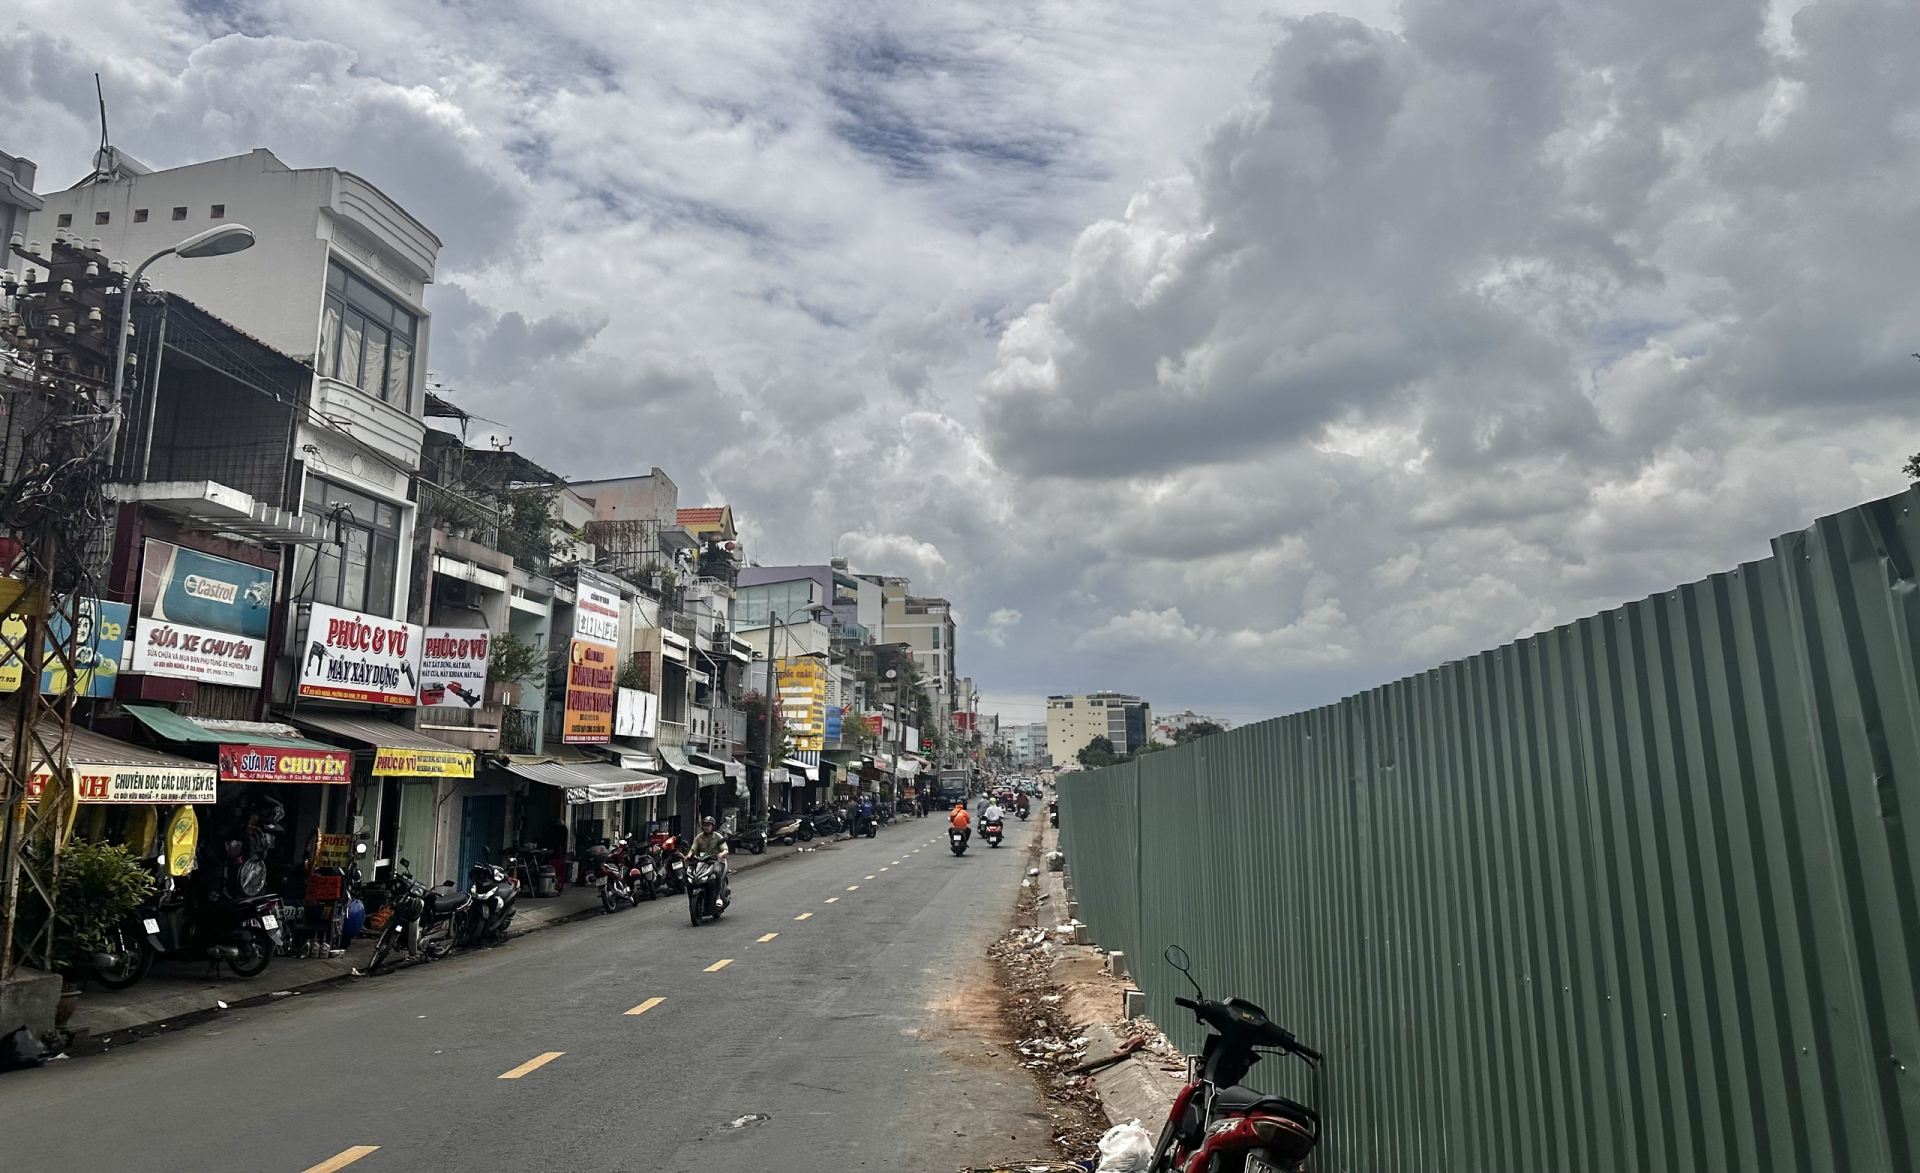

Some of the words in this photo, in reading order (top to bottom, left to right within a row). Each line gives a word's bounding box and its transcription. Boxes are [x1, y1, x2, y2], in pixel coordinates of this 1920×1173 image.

[197, 579, 234, 601] Castrol
[100, 615, 122, 641] be
[180, 634, 201, 652] XE
[372, 626, 386, 654] &
[458, 638, 470, 660] &
[302, 686, 310, 695] 47
[241, 750, 261, 772] SỬA
[262, 756, 277, 772] XE
[279, 754, 346, 776] CHUYÊN
[115, 770, 144, 790] CHUYÊN
[161, 772, 175, 790] CÁC
[204, 776, 214, 790] XE
